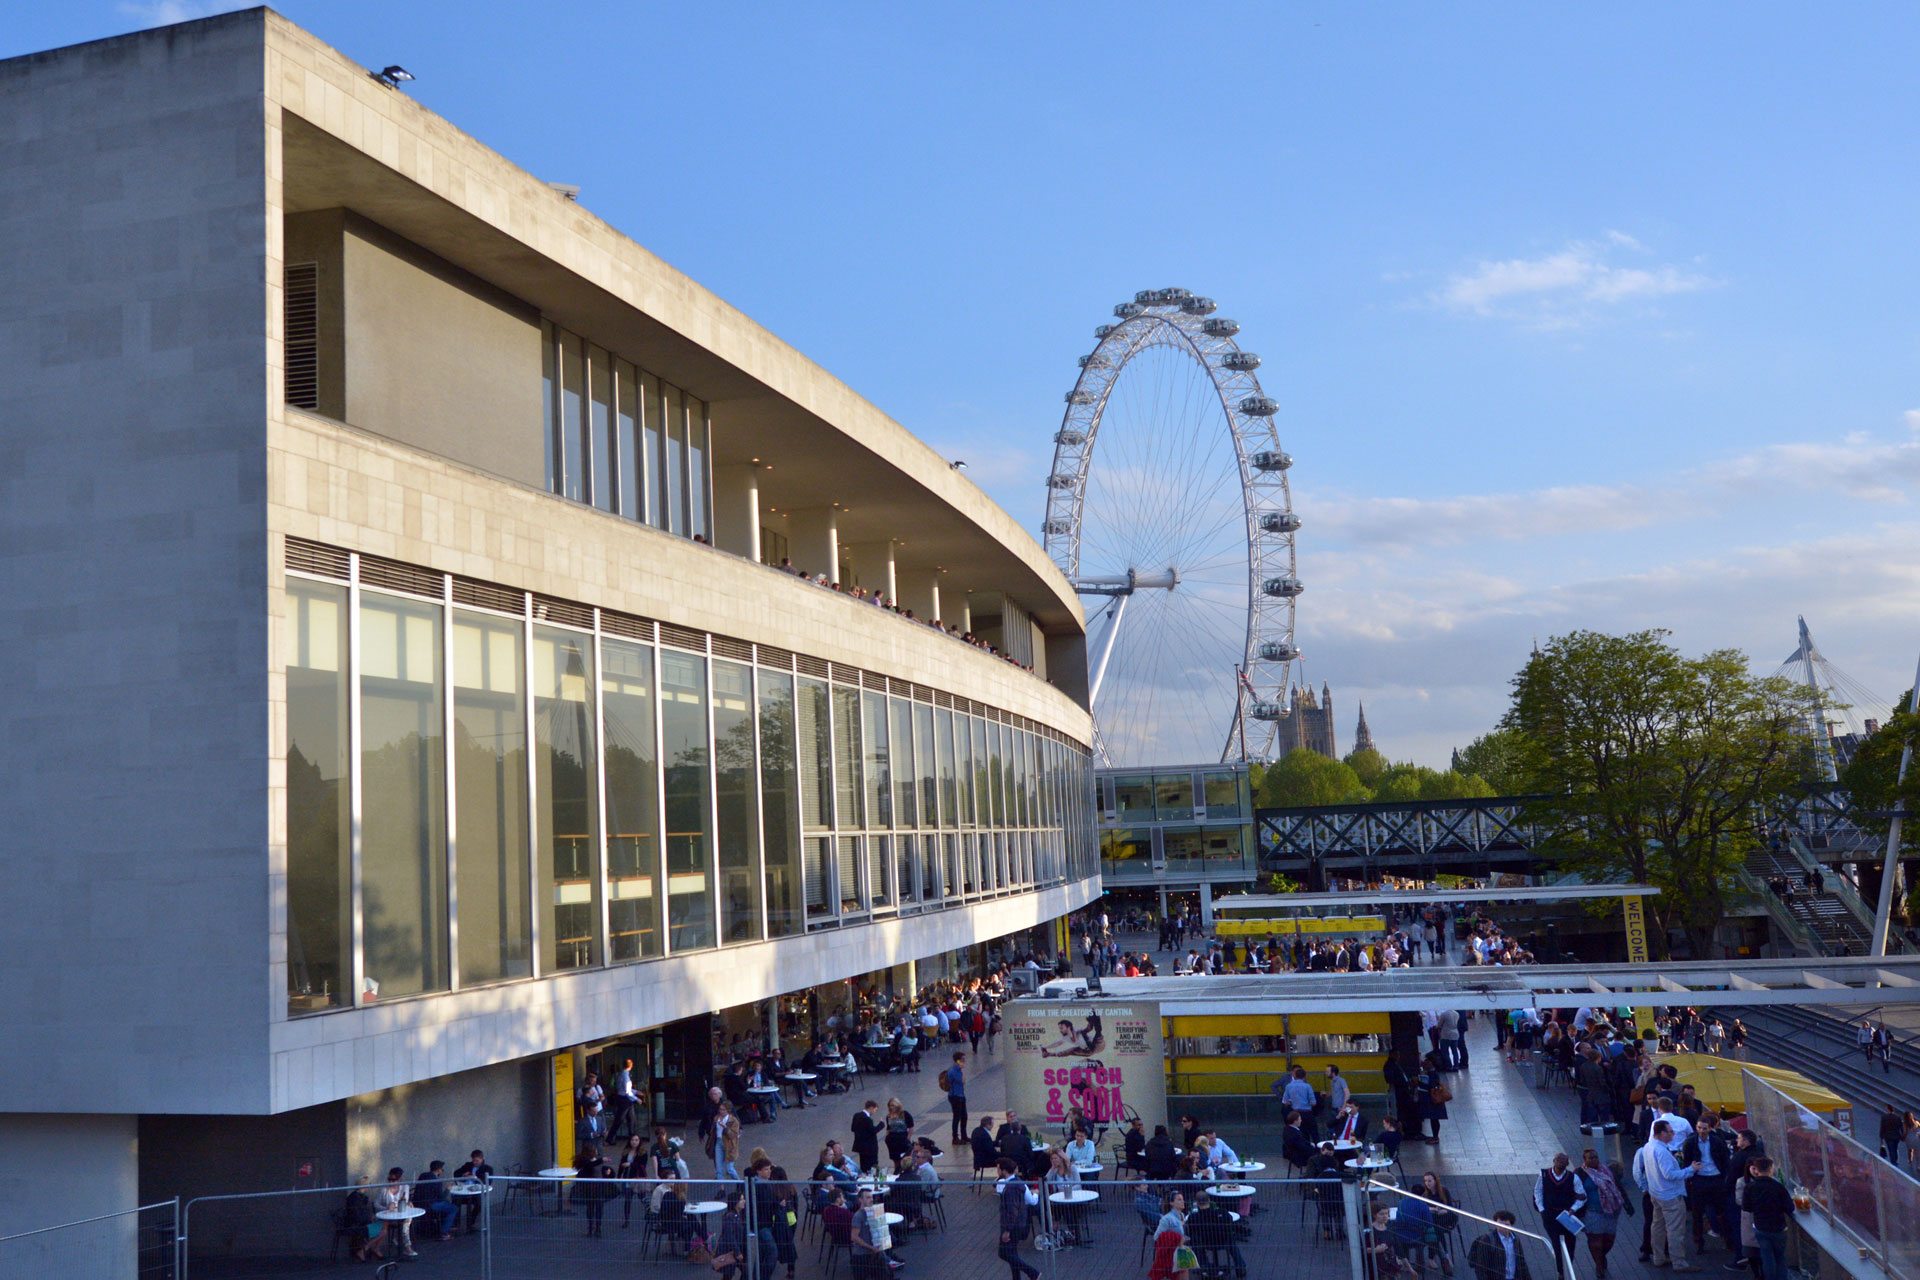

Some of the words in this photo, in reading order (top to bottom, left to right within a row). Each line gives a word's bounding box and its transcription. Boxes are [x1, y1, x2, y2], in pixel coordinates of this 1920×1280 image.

[1628, 902, 1644, 962] WELCOME
[1047, 1009, 1059, 1017] THE
[1060, 1009, 1094, 1017] CREATORS
[1095, 1008, 1104, 1017] OF
[1105, 1008, 1133, 1016] CANTINA
[1044, 1067, 1122, 1085] SCOTCH
[1045, 1087, 1064, 1117] &
[1068, 1086, 1125, 1121] SODA
